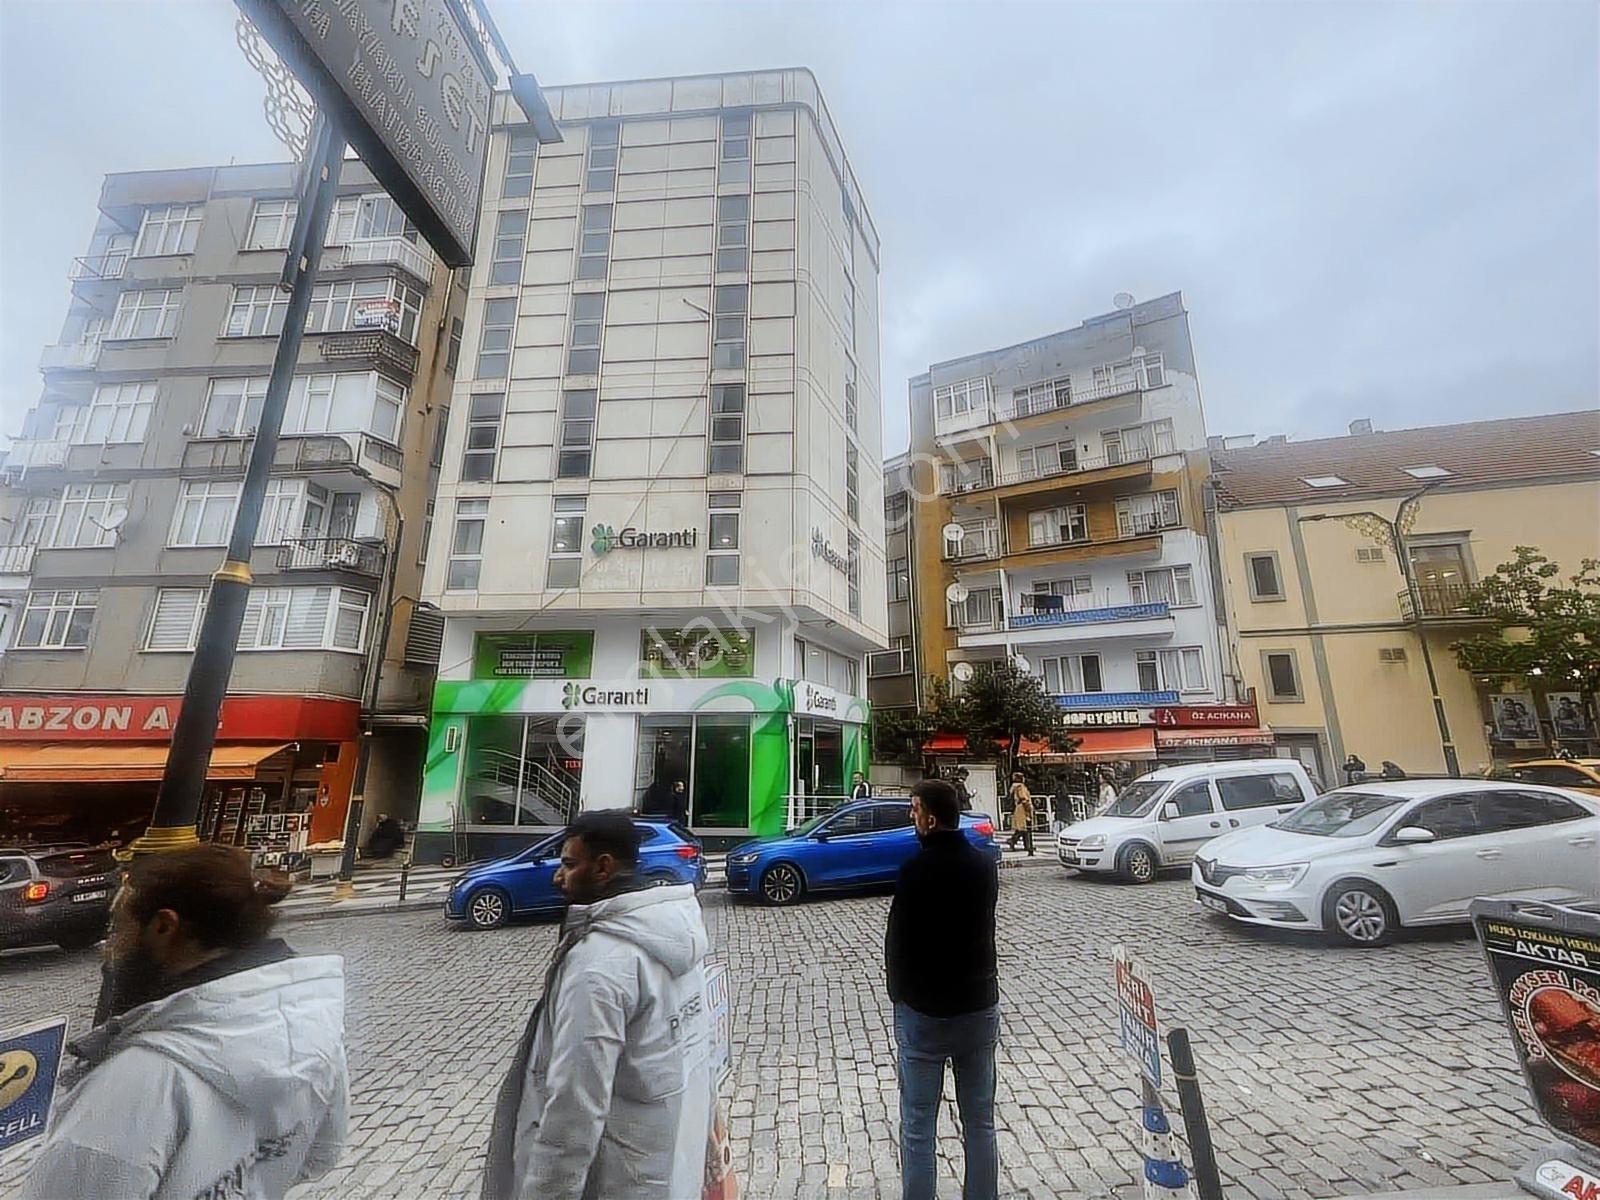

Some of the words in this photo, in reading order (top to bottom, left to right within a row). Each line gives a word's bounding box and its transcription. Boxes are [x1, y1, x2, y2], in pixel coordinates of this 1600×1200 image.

[619, 527, 697, 550] Garanti
[582, 686, 648, 705] Garanti
[1516, 940, 1589, 967] AKTAR
[0, 1113, 41, 1138] ELL
